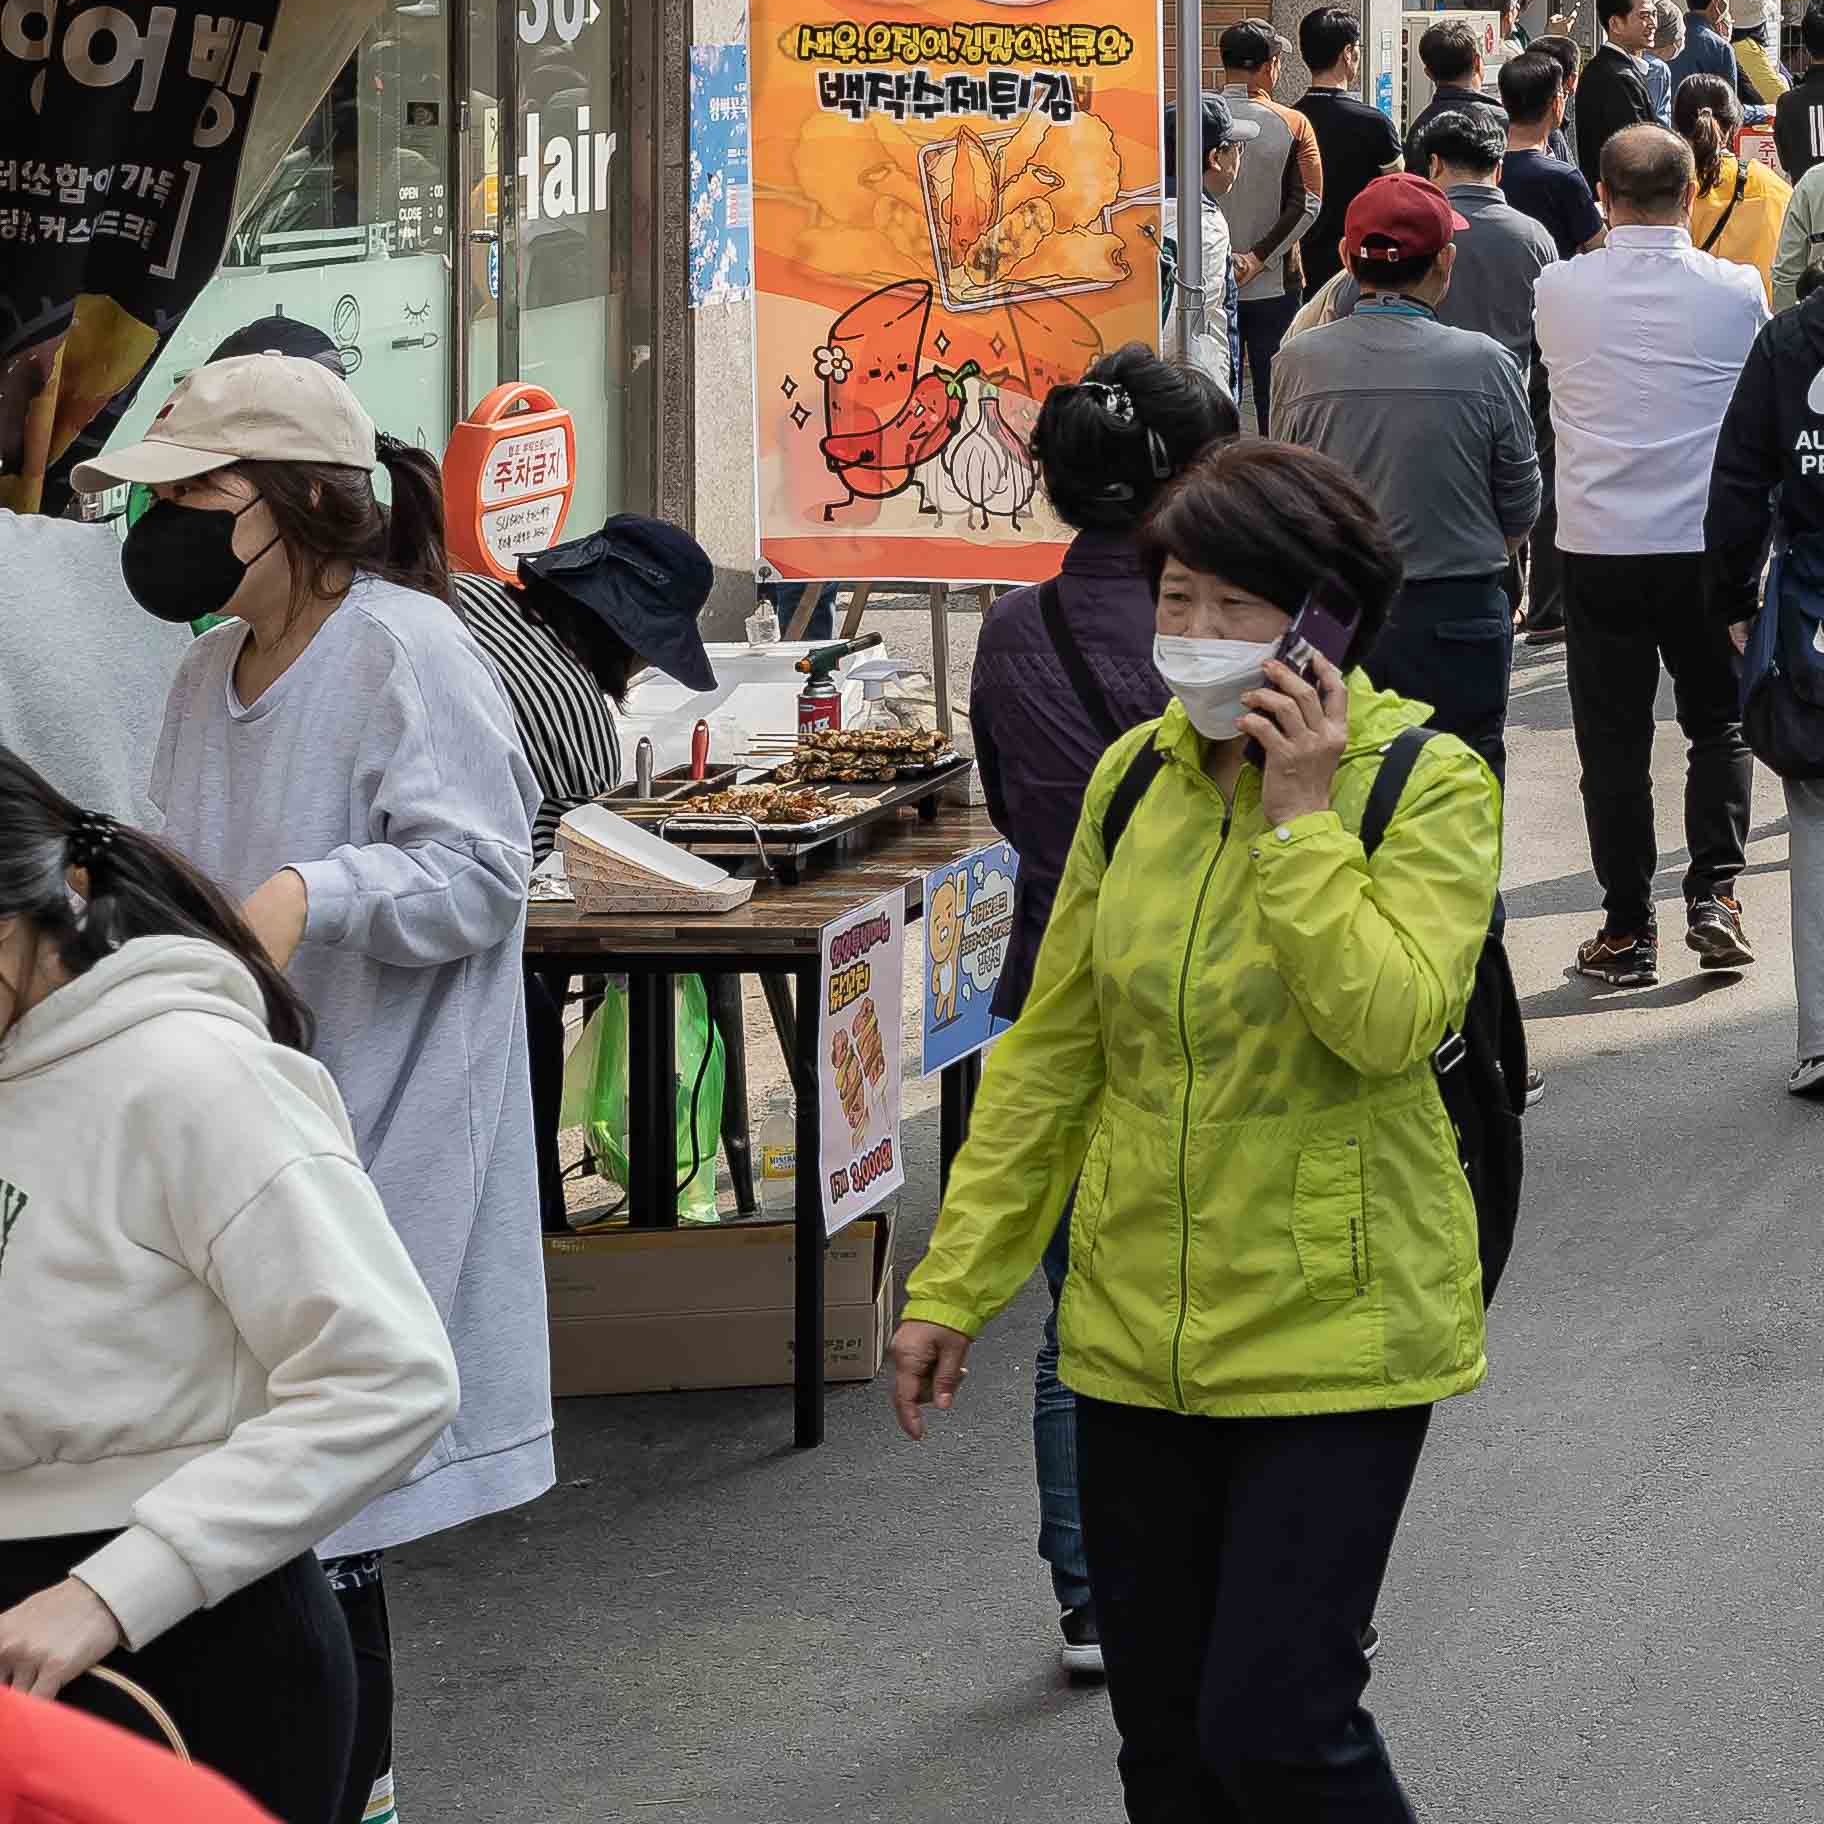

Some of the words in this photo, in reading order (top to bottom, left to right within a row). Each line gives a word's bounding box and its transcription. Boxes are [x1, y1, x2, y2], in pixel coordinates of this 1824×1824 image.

[398, 207, 423, 222] CLOSE
[493, 447, 561, 493] 주차금지
[851, 1136, 894, 1193] 3,000원
